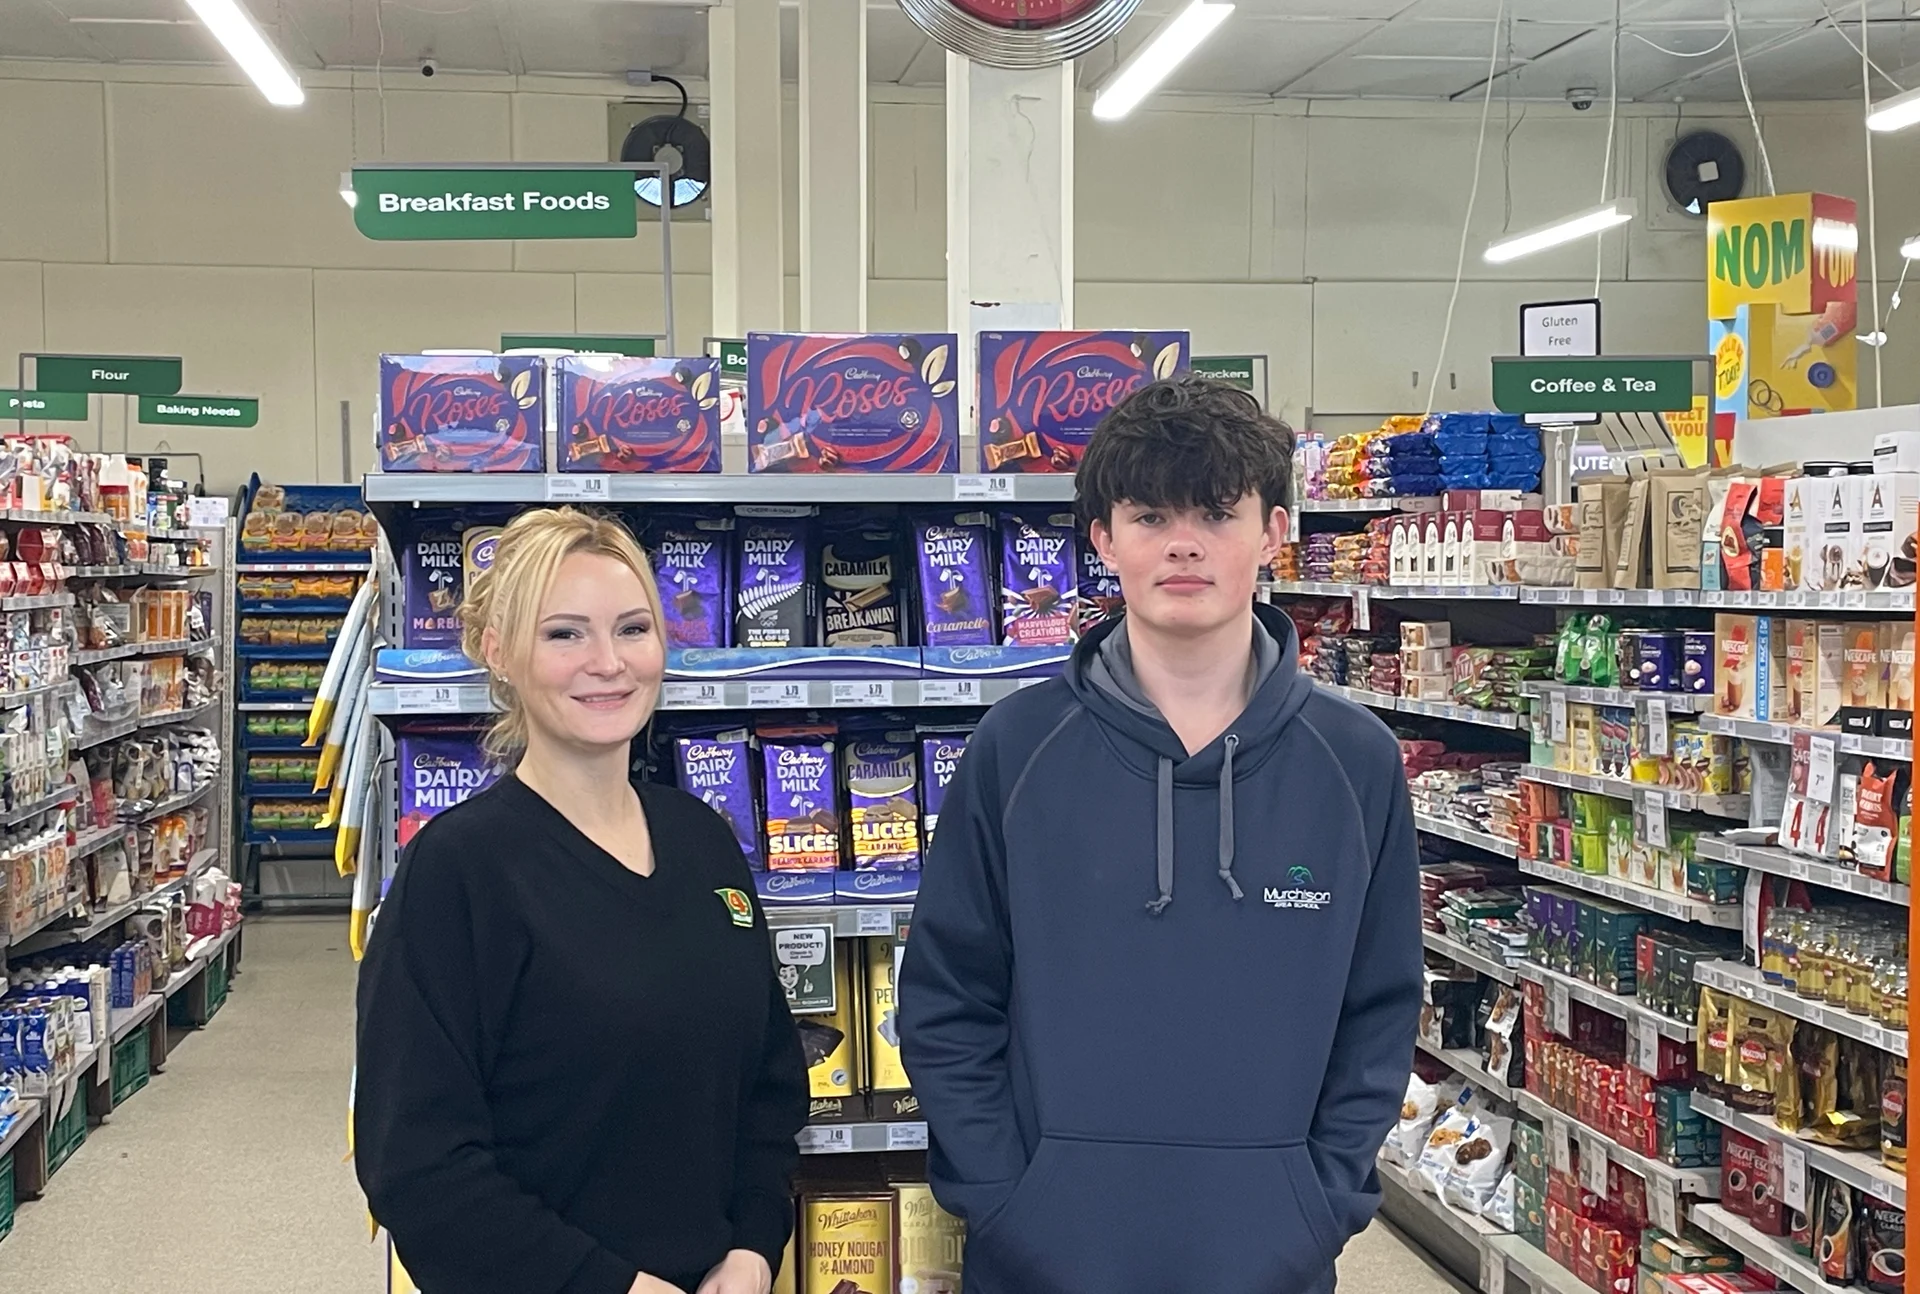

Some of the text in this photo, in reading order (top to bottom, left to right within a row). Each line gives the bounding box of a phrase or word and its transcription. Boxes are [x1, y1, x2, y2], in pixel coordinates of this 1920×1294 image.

[378, 191, 610, 212] Breakfast Foods
[1716, 219, 1806, 289] NOM
[1542, 316, 1578, 328] Gluten
[1548, 335, 1572, 346] Free
[91, 370, 130, 381] Flour
[844, 367, 881, 382] Cadbury
[1076, 365, 1113, 380] Cadbury
[1530, 377, 1657, 393] Coffee & Tea
[785, 371, 919, 427] Roses
[157, 404, 241, 417] Baking Needs
[409, 389, 508, 435] Roses
[592, 388, 690, 432] Roses
[925, 525, 970, 541] Cadbury
[661, 542, 712, 555] DAIRY
[744, 540, 795, 552] DAIRY
[924, 537, 974, 555] DAIRY
[1015, 539, 1066, 552] DAIRY
[421, 555, 462, 568] MILK
[666, 555, 705, 568] MILK
[748, 553, 787, 566] MILK
[929, 551, 969, 567] MILK
[1020, 552, 1059, 565] MILK
[825, 562, 888, 576] CARAMILK
[1089, 565, 1119, 577] MIL
[826, 606, 895, 632] BREAKAWAY
[1018, 618, 1067, 630] MARVELLOUS
[1019, 626, 1067, 638] CREATIONS
[1758, 636, 1769, 667] PACK
[1758, 668, 1768, 700] VALUE
[687, 744, 733, 761] Cadbury
[778, 750, 825, 766] Cadbury
[856, 743, 900, 757] Cadbury
[413, 753, 461, 769] Cadbury
[686, 756, 737, 775] DAIRY
[415, 768, 490, 788] DAIRY
[776, 764, 828, 779] DAIRY
[847, 760, 912, 780] CARAMILK
[692, 771, 733, 788] MILK
[781, 779, 821, 793] MILK
[415, 788, 473, 808] MILK
[852, 820, 918, 841] SLICES
[769, 834, 839, 854] SLICES
[766, 875, 816, 893] Cadbury
[854, 873, 903, 891] Cadbury
[1263, 887, 1331, 901] Murchison
[1293, 902, 1321, 910] SCHOOL
[778, 942, 823, 950] PRODUCT!
[817, 1207, 878, 1232] Whittaker's
[810, 1241, 845, 1258] HONEY
[847, 1241, 888, 1258] NOUGAT
[831, 1259, 875, 1275] ALMOND
